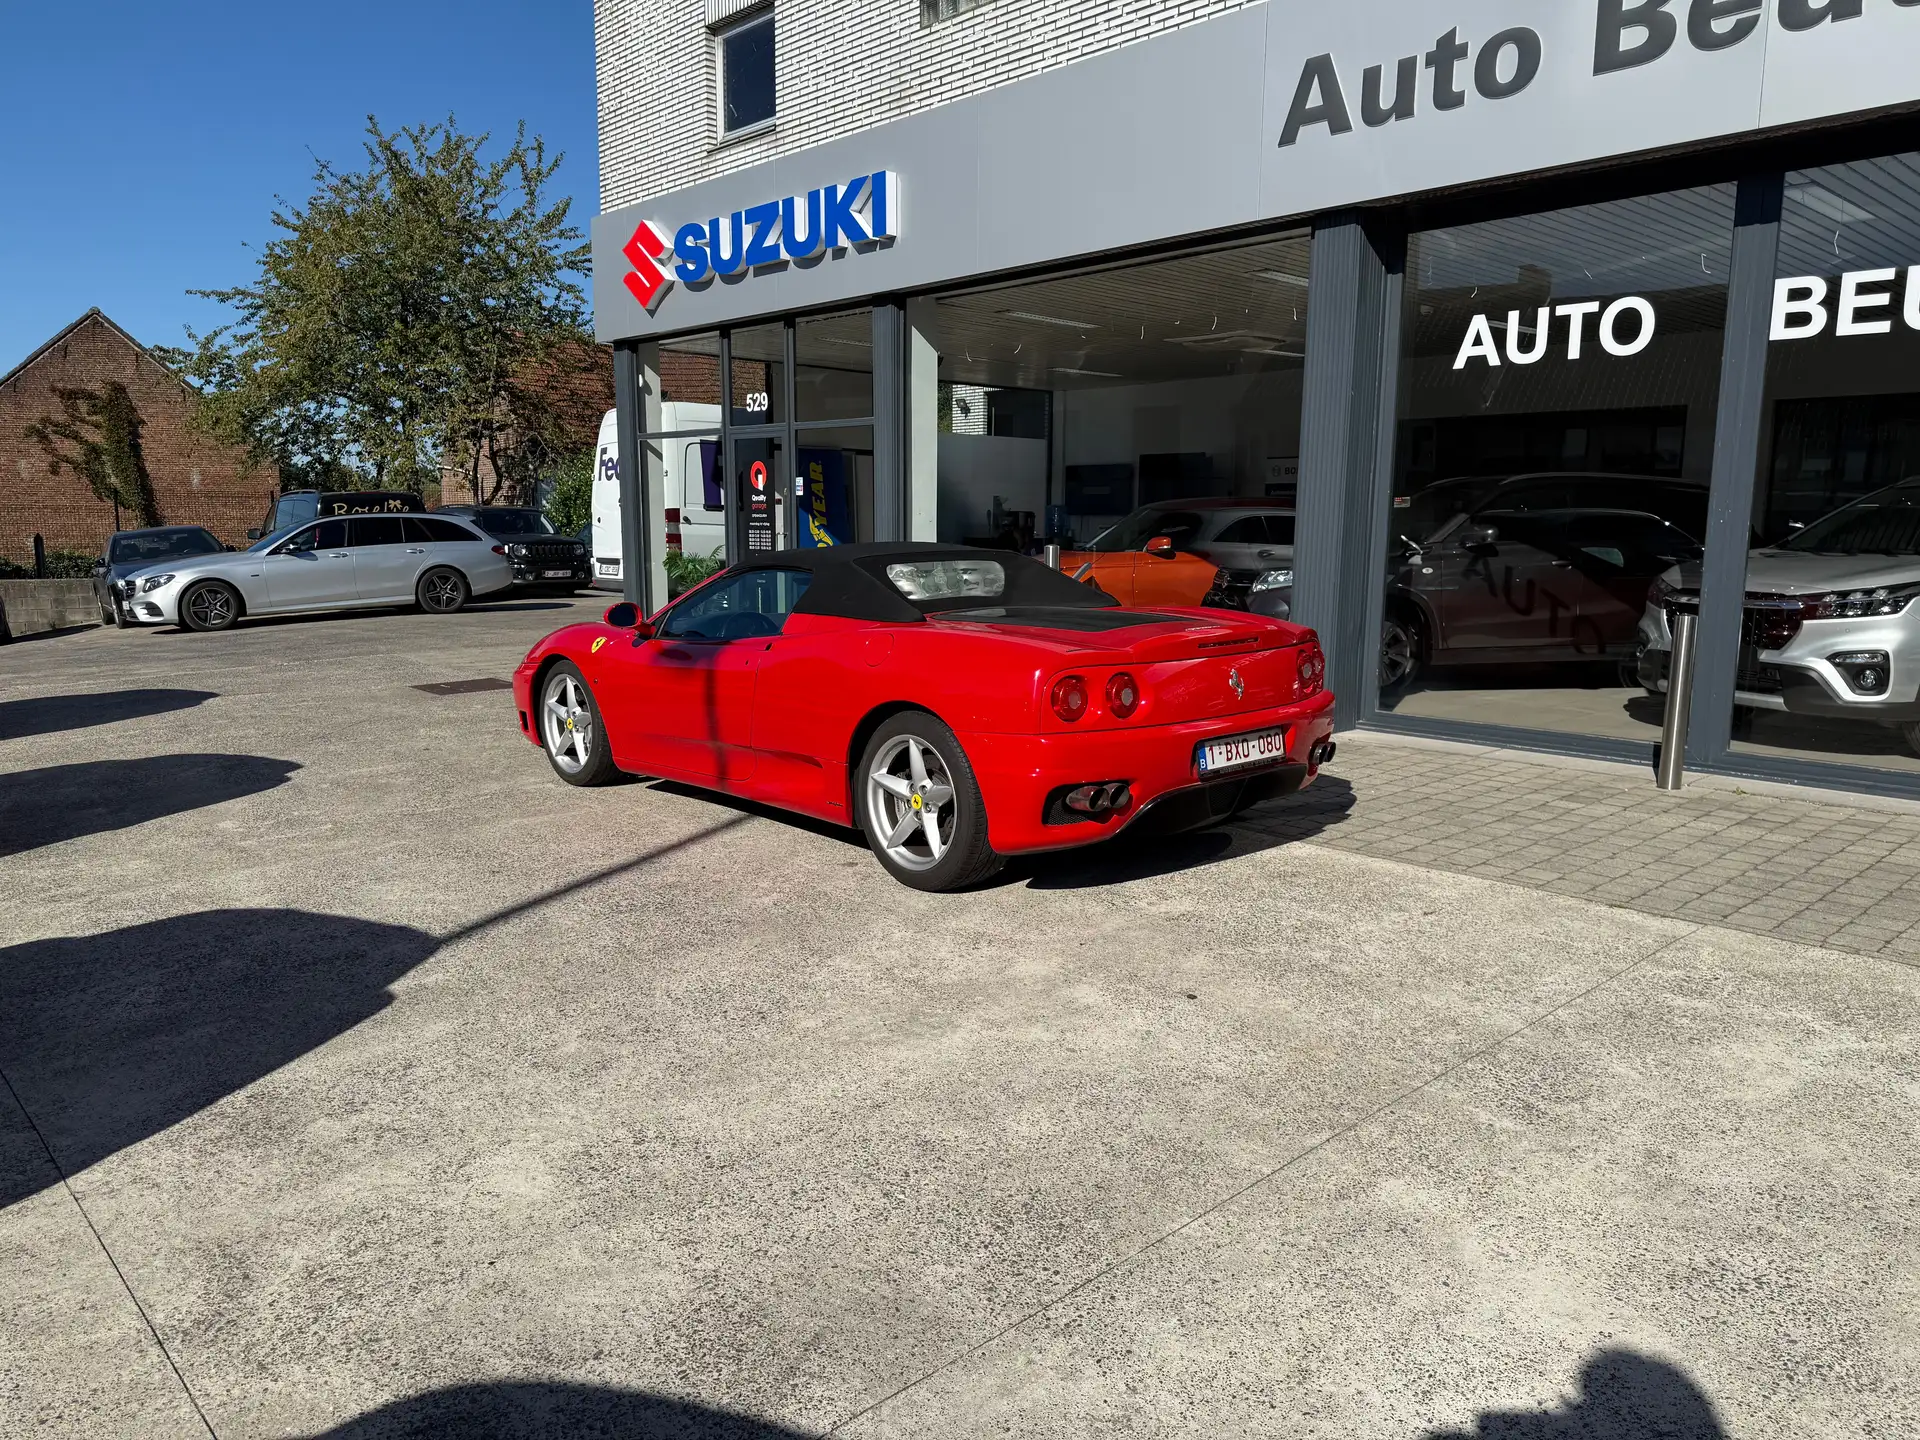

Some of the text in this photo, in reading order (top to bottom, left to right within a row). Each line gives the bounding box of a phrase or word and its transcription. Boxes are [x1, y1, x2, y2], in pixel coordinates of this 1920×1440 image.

[1277, 26, 1543, 149] Auto
[674, 170, 892, 283] SUZUKI
[1452, 295, 1656, 370] AUTO
[746, 392, 769, 412] 529
[1284, 466, 1298, 475] BO
